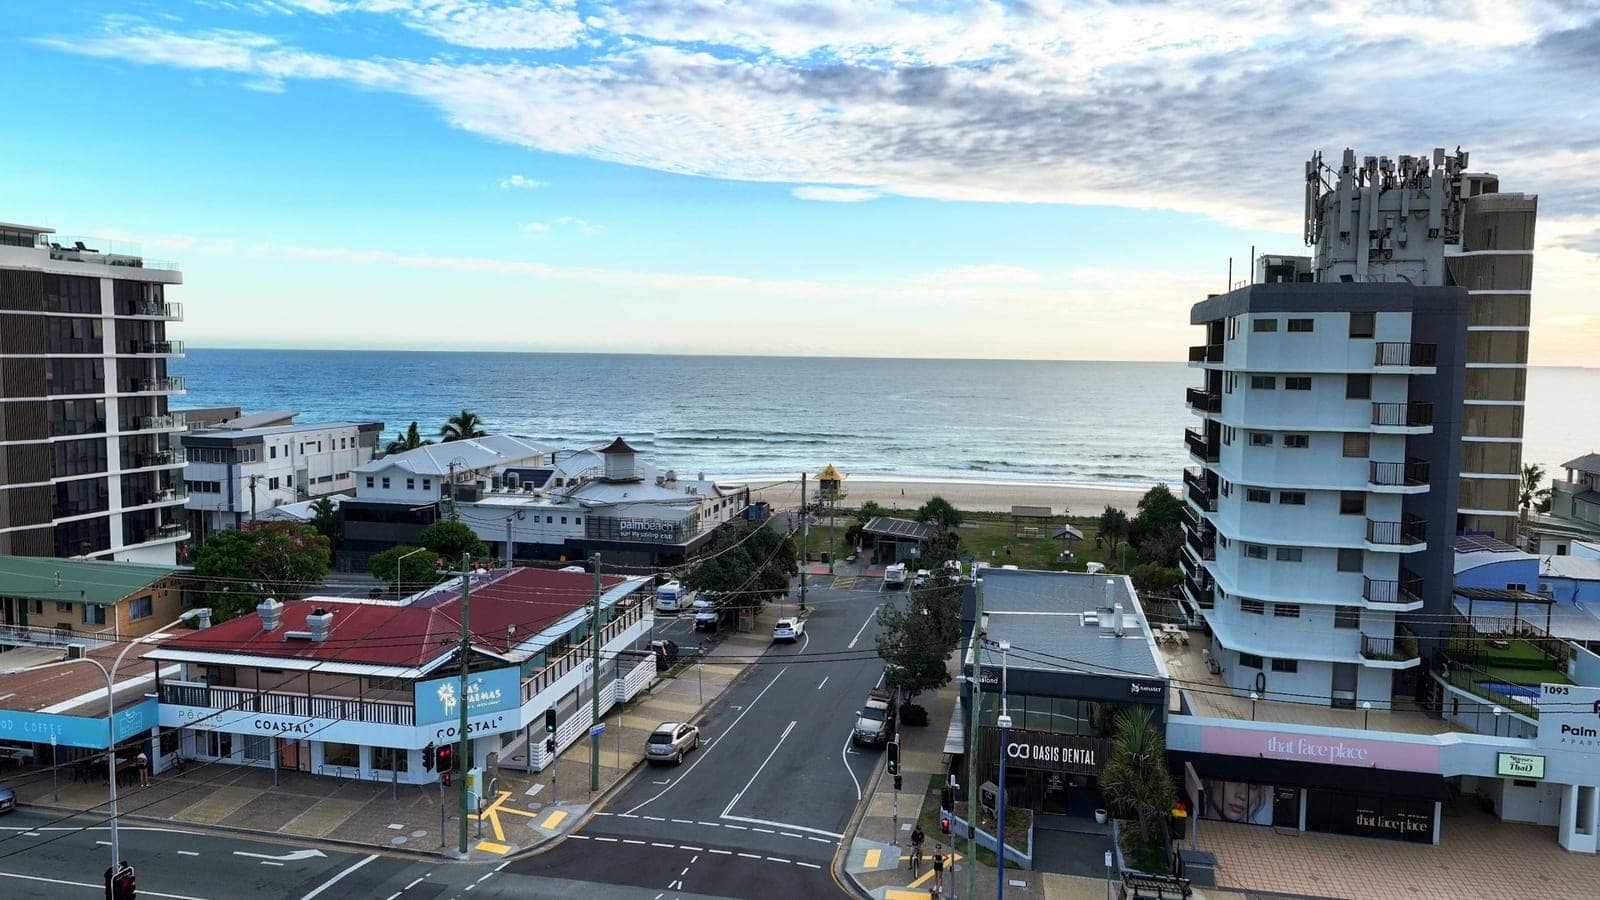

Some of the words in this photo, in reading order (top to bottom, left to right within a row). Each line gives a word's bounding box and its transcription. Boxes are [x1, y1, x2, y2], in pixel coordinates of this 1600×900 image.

[620, 519, 673, 531] palmbeach
[1543, 686, 1569, 695] 1093
[24, 721, 64, 735] COFFEE
[1561, 724, 1597, 737] Palm
[1033, 745, 1059, 762] OASIS
[1062, 748, 1096, 766] DENTAL
[1268, 737, 1293, 753] that
[1297, 738, 1328, 756] face
[1328, 743, 1368, 761] place
[1356, 814, 1375, 827] that
